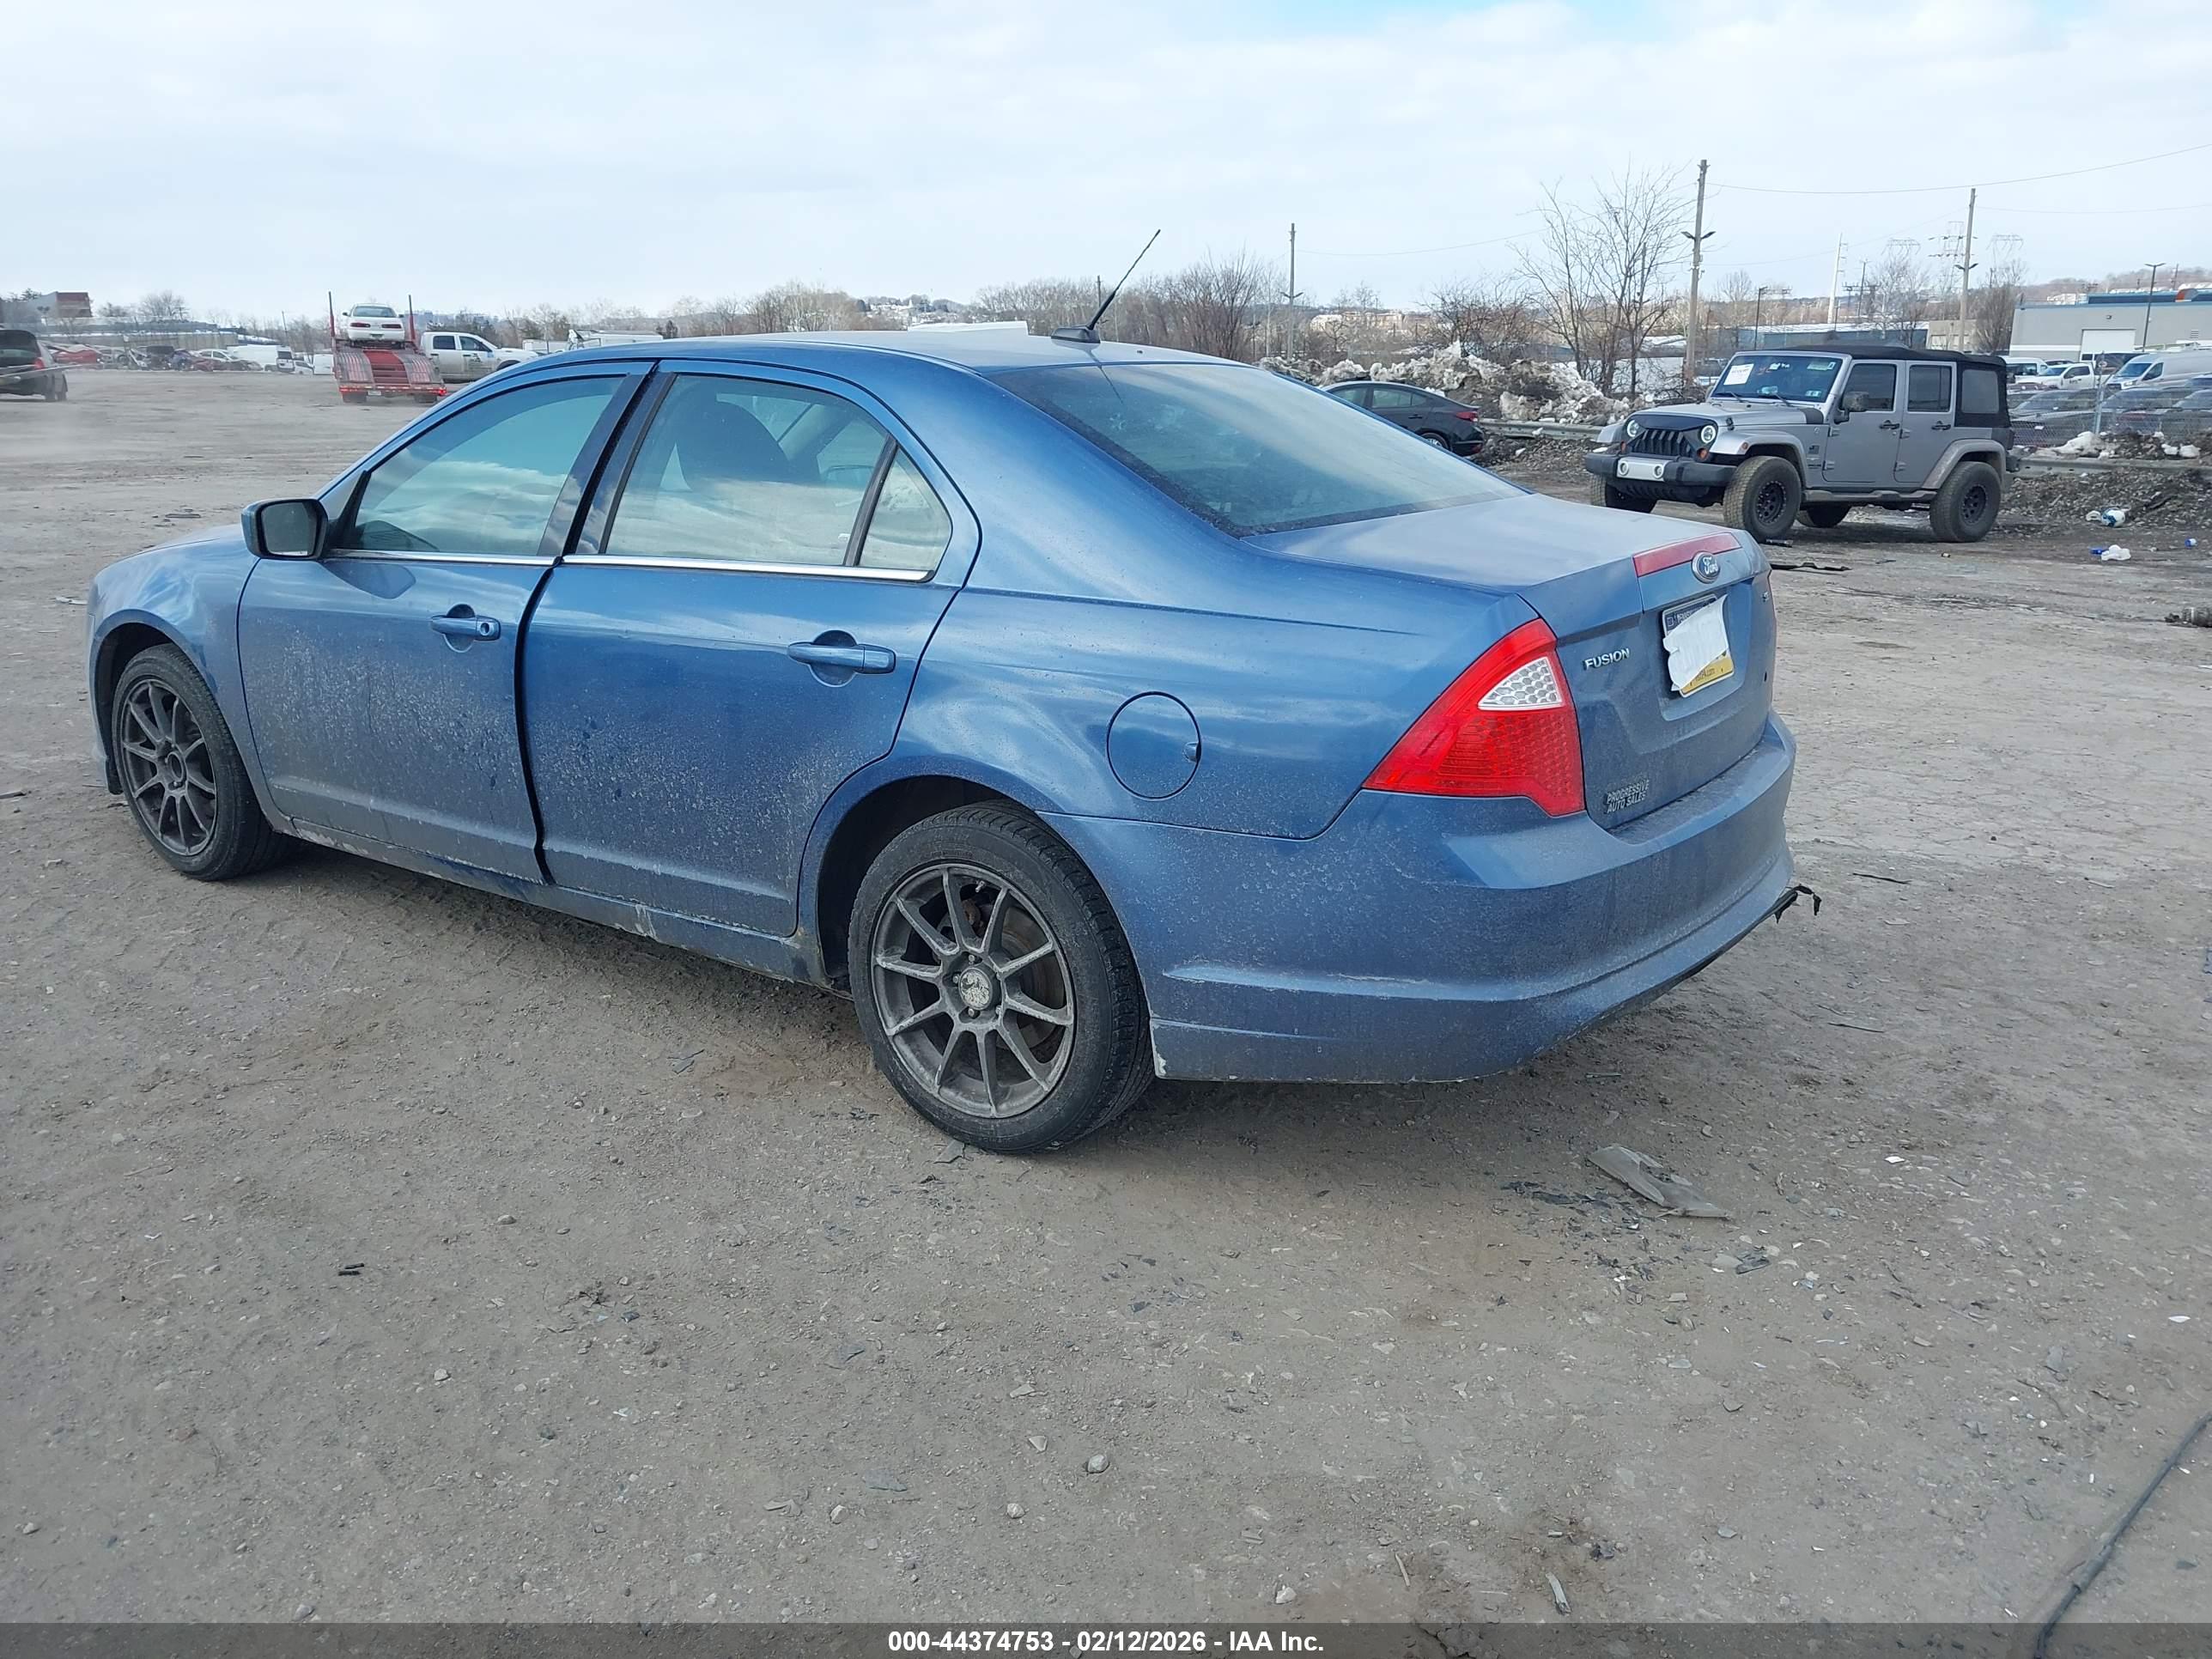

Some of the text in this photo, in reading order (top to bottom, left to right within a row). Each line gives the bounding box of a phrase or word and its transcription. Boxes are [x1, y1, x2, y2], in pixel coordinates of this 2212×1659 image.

[1703, 556, 1718, 574] Ford
[1584, 648, 1630, 670] FUSION
[1607, 780, 1649, 804] PROGRESSIVE
[1607, 791, 1646, 813] AUTO SALES
